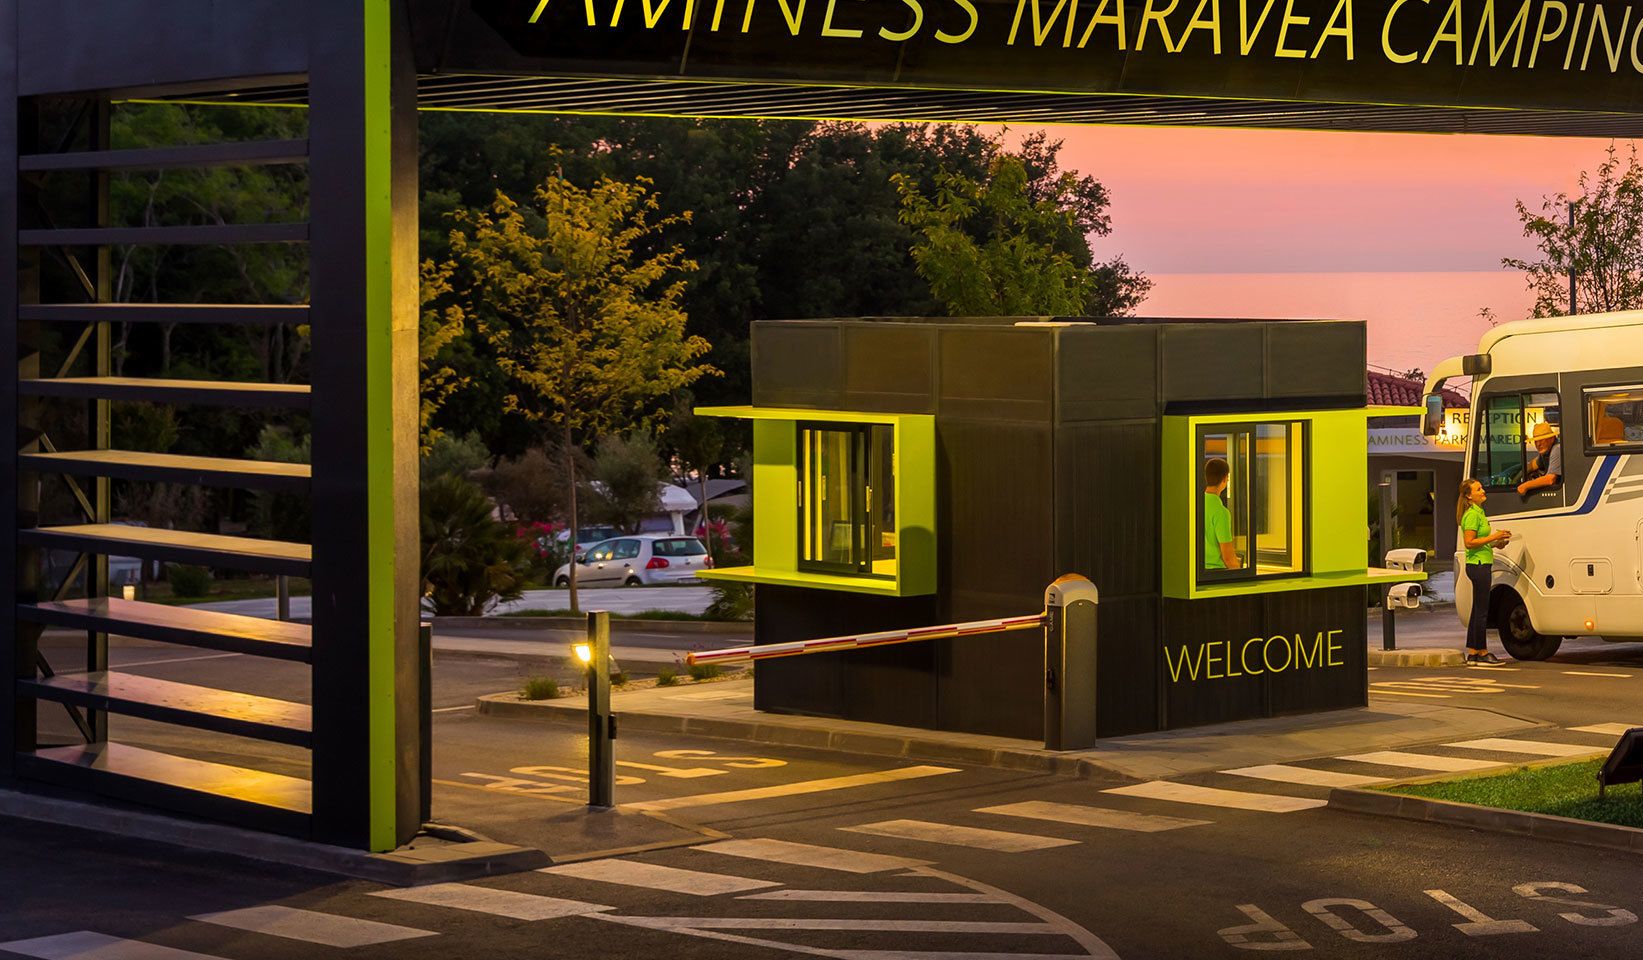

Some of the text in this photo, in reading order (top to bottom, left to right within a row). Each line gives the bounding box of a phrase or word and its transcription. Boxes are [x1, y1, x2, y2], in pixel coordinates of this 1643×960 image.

[1368, 434, 1429, 446] AMINESS
[1434, 434, 1468, 445] PARK
[1163, 629, 1345, 683] WELCOME
[1216, 880, 1639, 951] STOP
